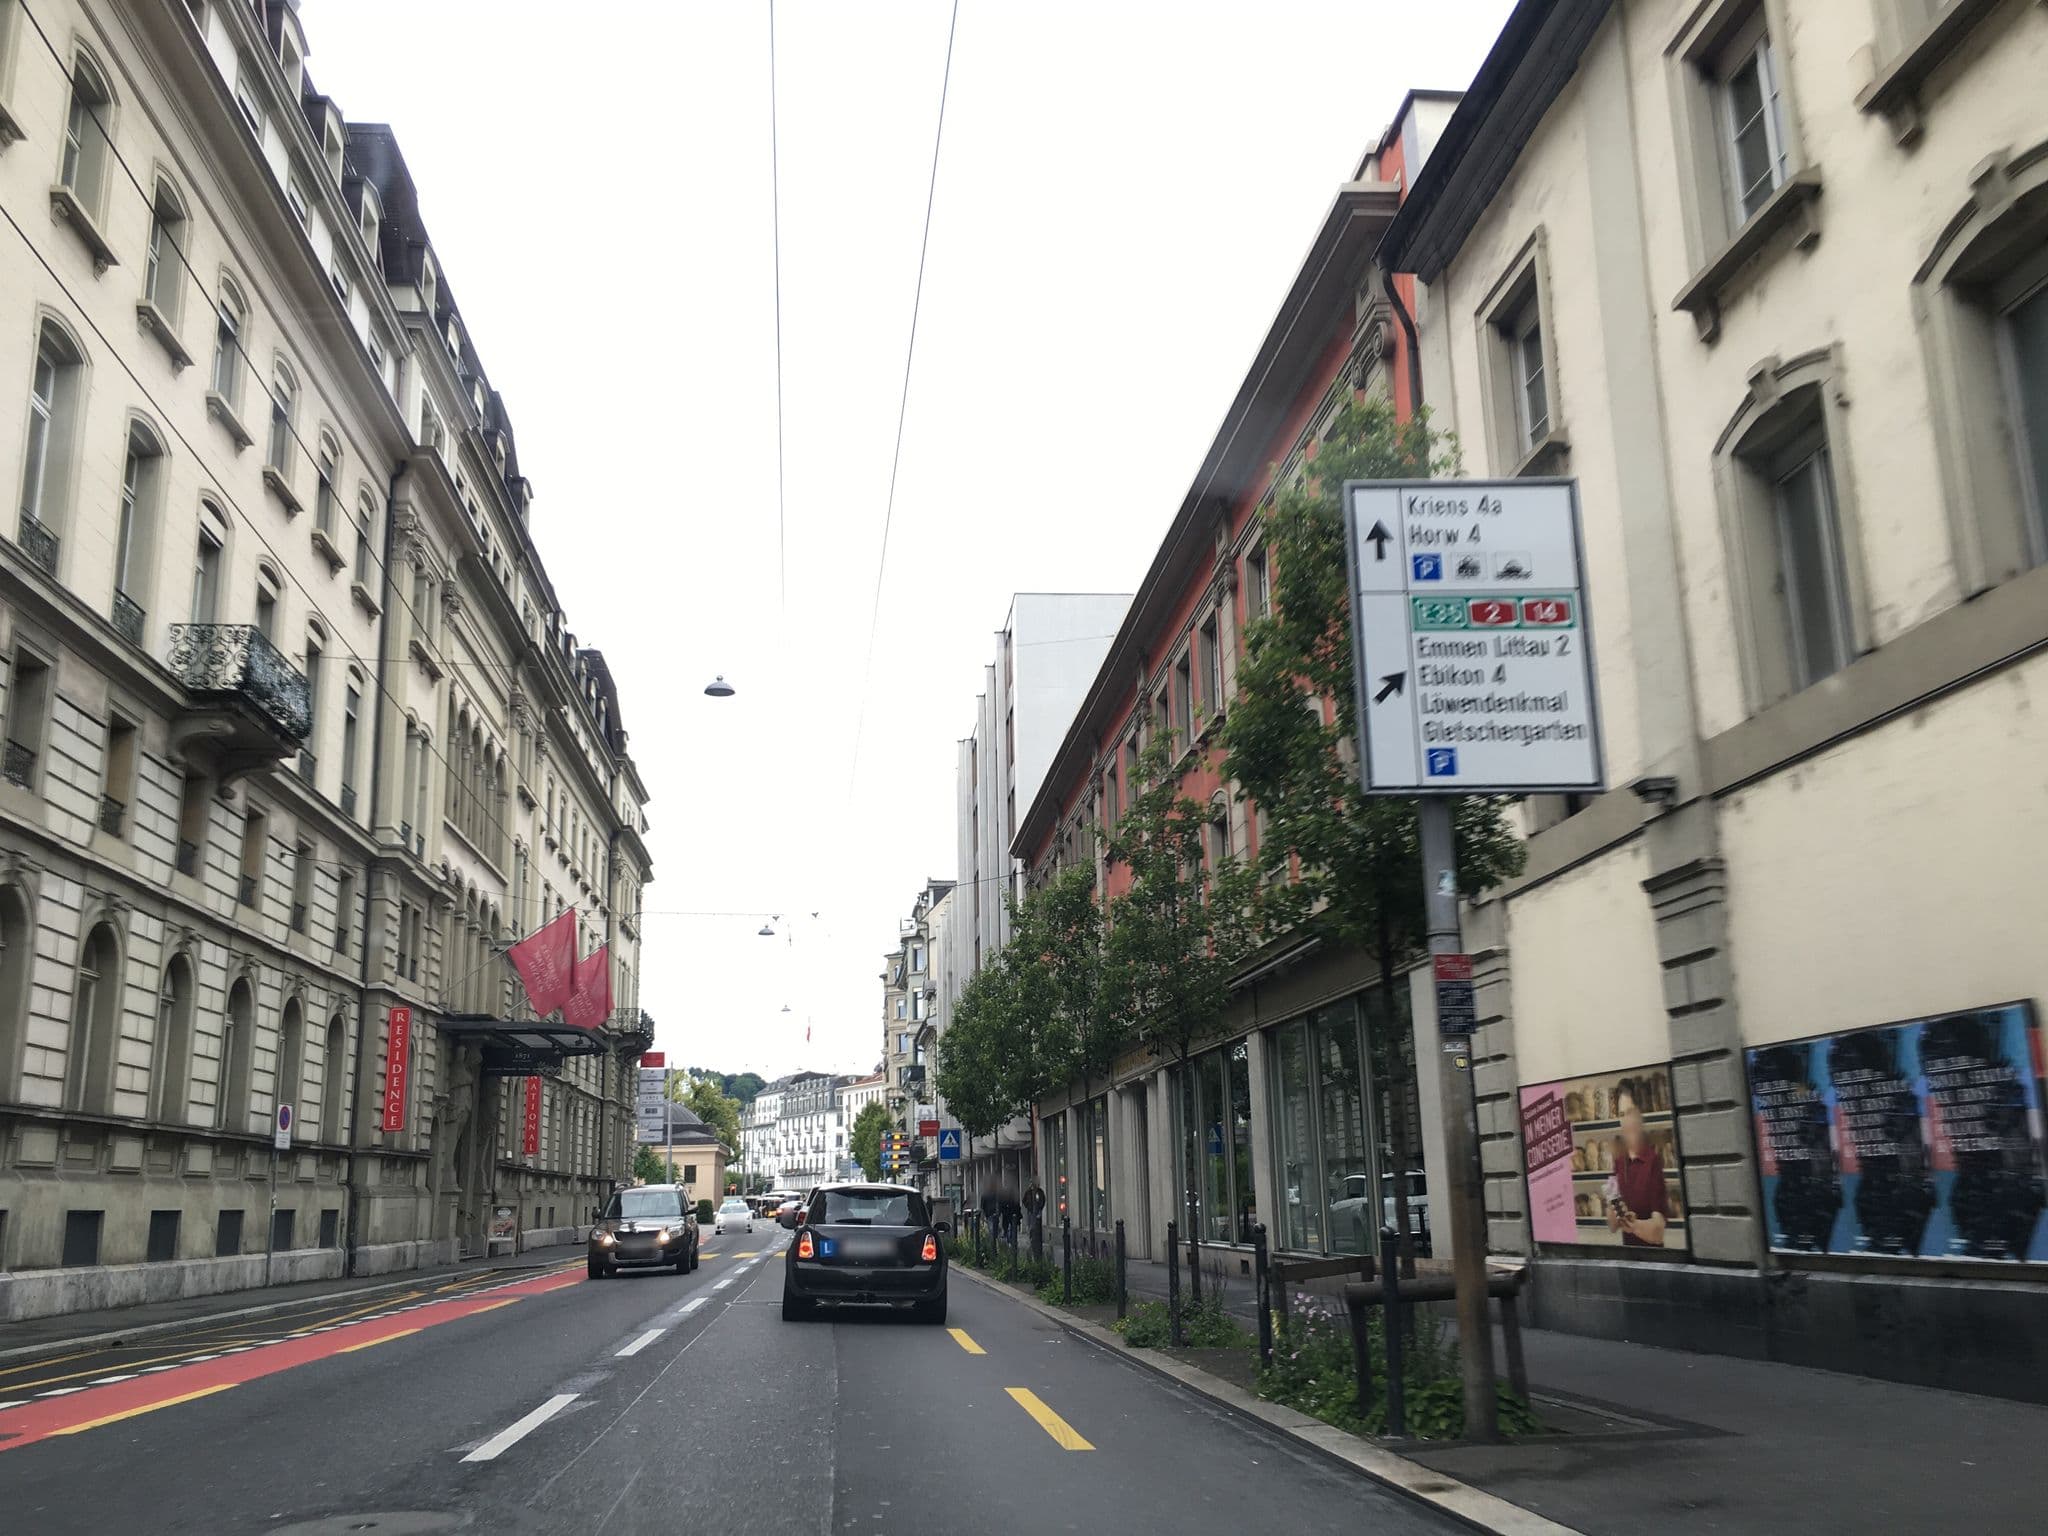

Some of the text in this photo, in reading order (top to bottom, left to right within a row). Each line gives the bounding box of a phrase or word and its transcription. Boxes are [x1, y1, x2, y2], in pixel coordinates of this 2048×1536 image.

[1408, 493, 1503, 516] Kriens 4a
[1408, 522, 1482, 545] Horw 4
[1485, 602, 1502, 622] 2
[1533, 601, 1559, 622] 14
[1417, 634, 1573, 660] Emmen Littau 2
[1418, 663, 1508, 687] Ebikon 4
[1421, 690, 1569, 717] Löwendenkmal
[1422, 718, 1587, 748] Gletschergarten
[389, 1012, 406, 1127] RESIDENCE
[1525, 1122, 1535, 1145] IN
[824, 1242, 833, 1255] L
